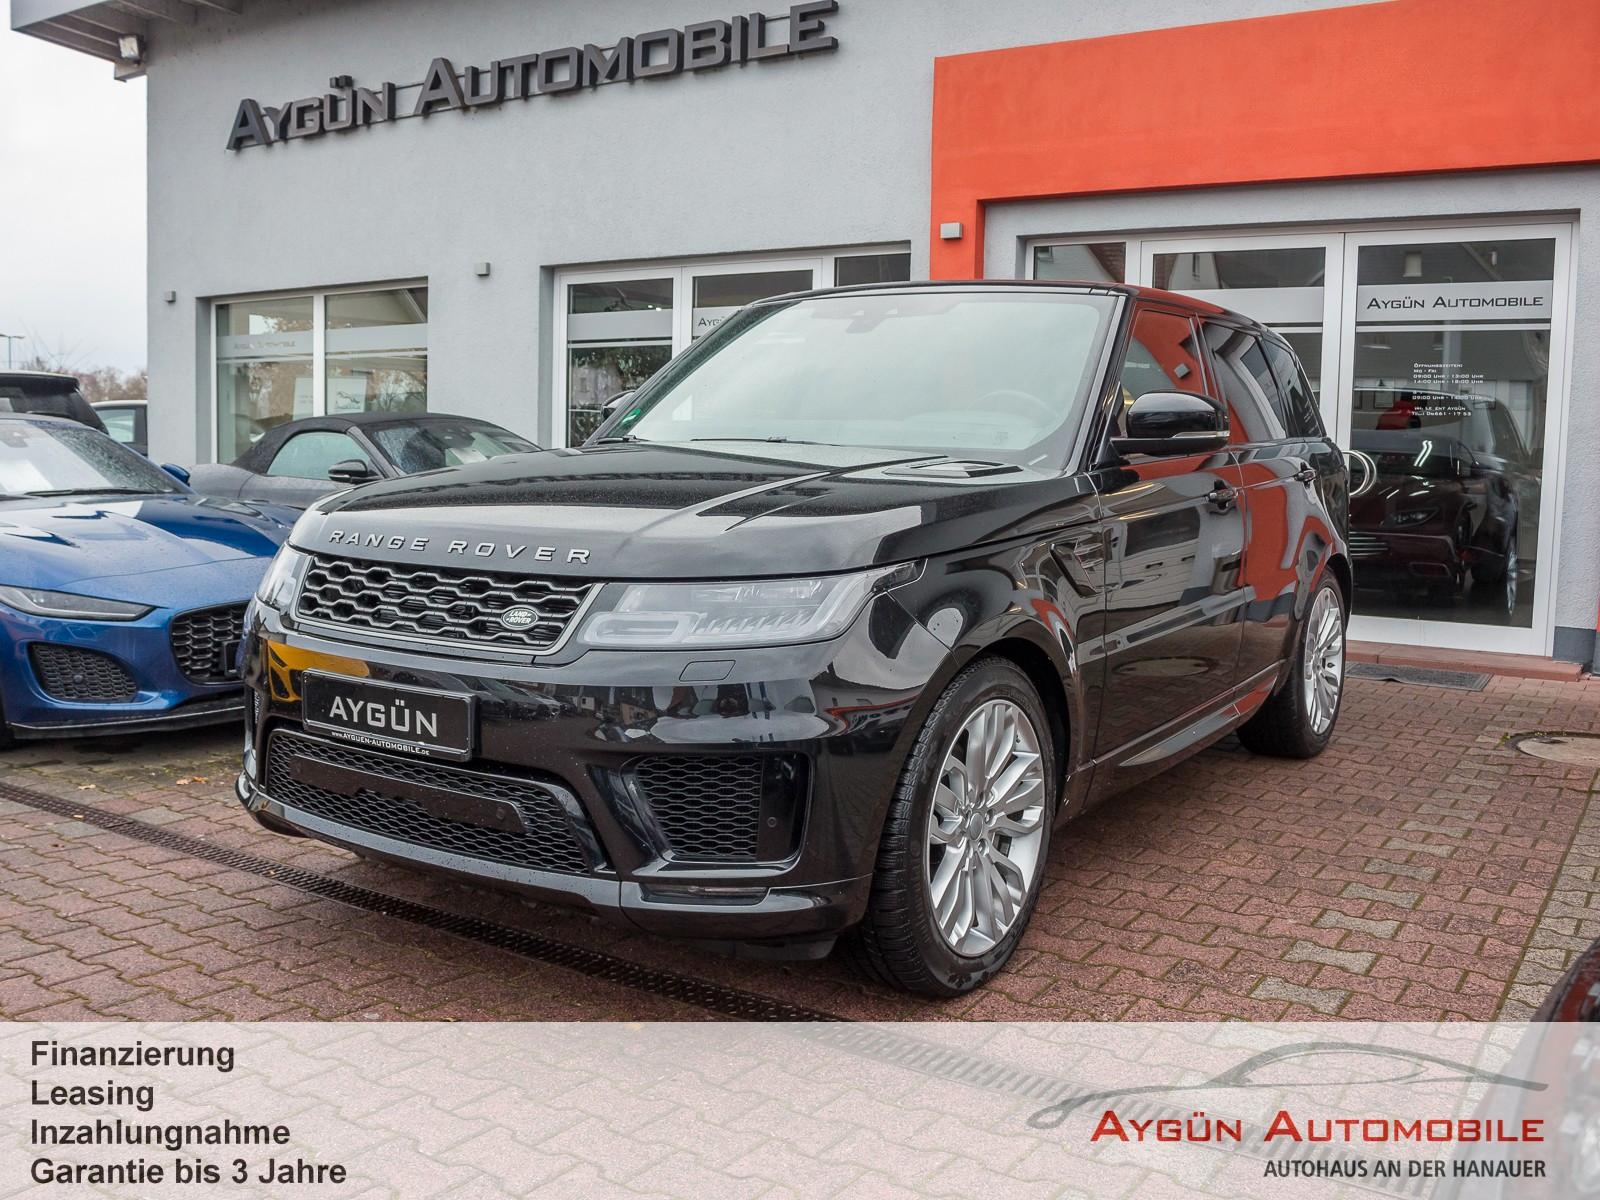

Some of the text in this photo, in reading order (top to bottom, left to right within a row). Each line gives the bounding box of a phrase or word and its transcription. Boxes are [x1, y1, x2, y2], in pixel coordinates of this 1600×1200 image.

[226, 0, 839, 150] AYGÜN AUTOMOBILE
[1367, 296, 1544, 309] AYGÜN AUTOMOBILE
[328, 530, 592, 564] RANGE ROVER
[508, 616, 532, 624] ROVER
[329, 695, 438, 738] AYGÜN
